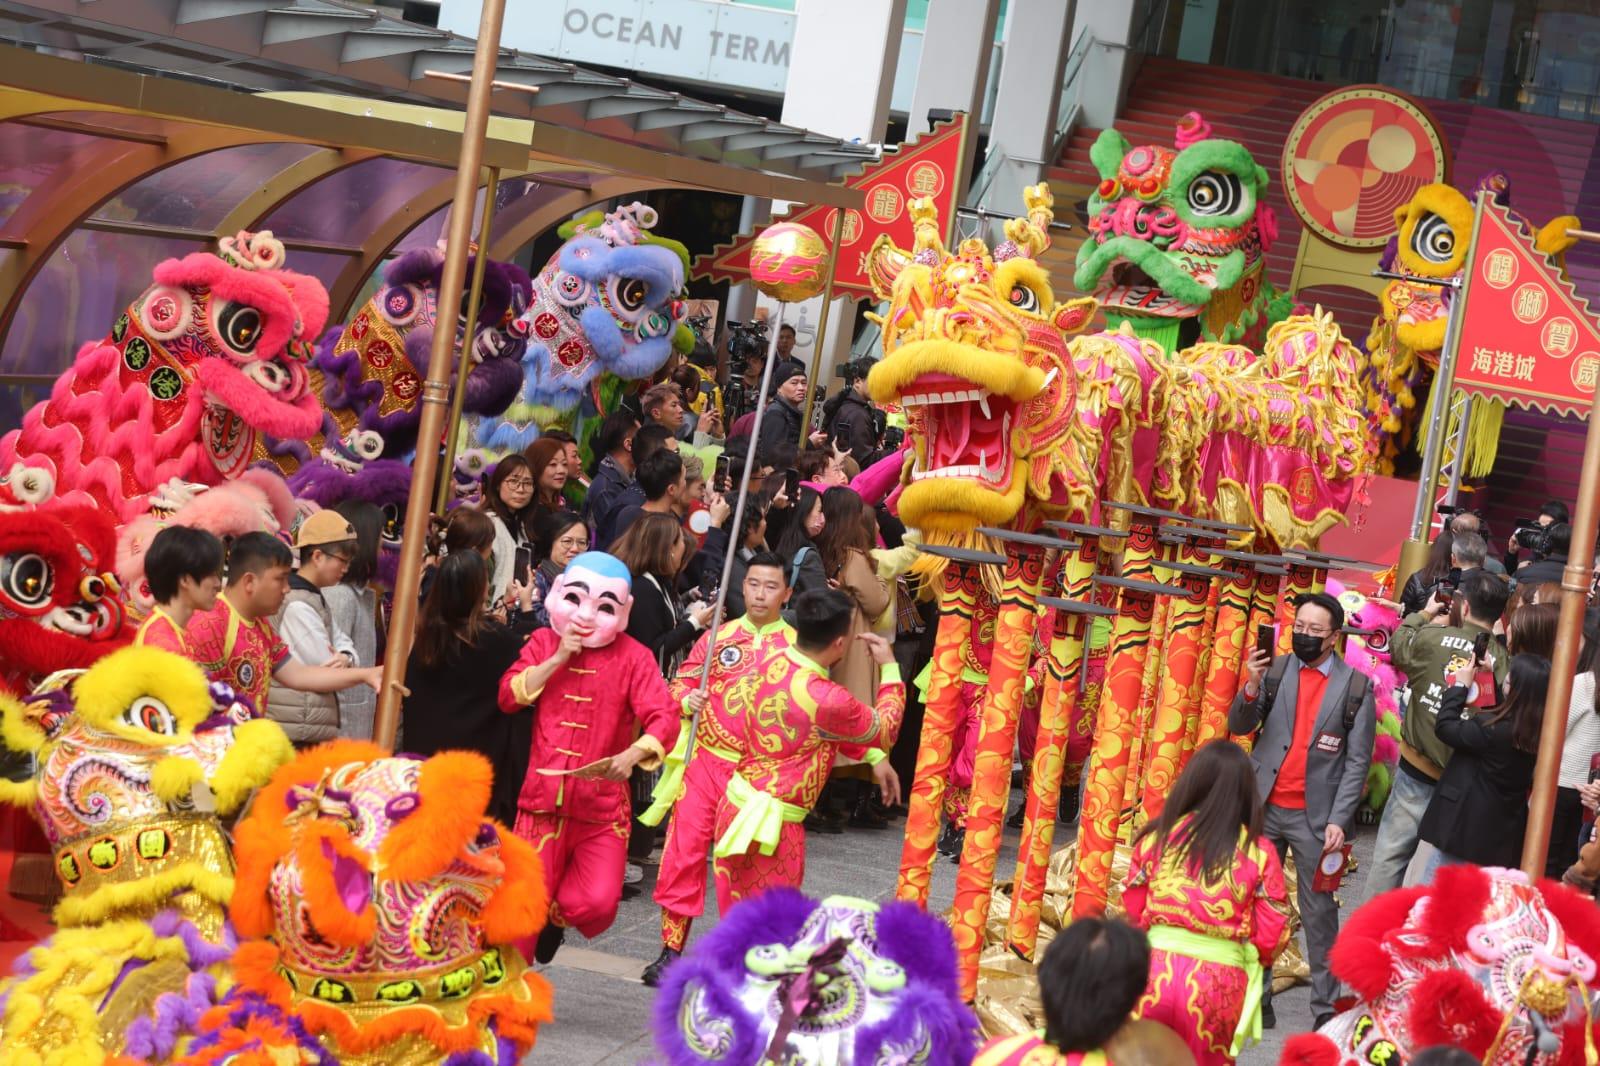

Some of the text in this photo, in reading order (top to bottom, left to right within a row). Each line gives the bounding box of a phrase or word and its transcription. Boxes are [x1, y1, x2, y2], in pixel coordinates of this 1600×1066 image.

[564, 8, 790, 67] OCEAN TERM
[1470, 346, 1536, 382] 海港城
